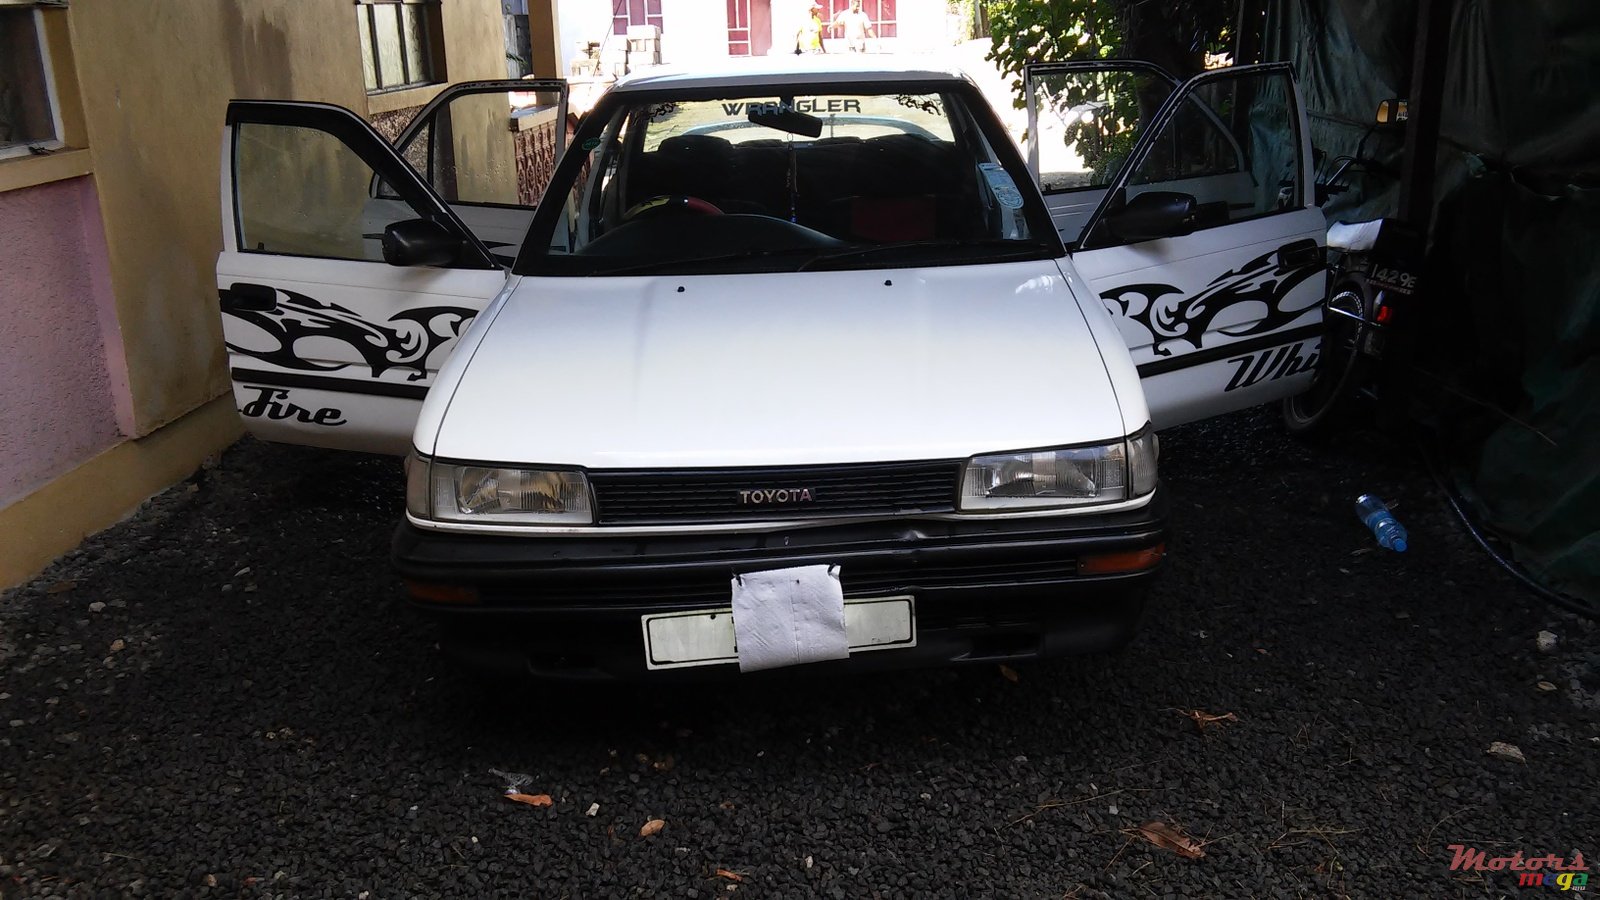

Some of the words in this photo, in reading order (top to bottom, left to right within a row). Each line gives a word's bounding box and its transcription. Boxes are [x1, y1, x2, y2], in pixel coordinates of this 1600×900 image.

[722, 99, 861, 117] WRANGLER
[238, 385, 347, 426] Fire
[739, 488, 813, 504] TOYOTA
